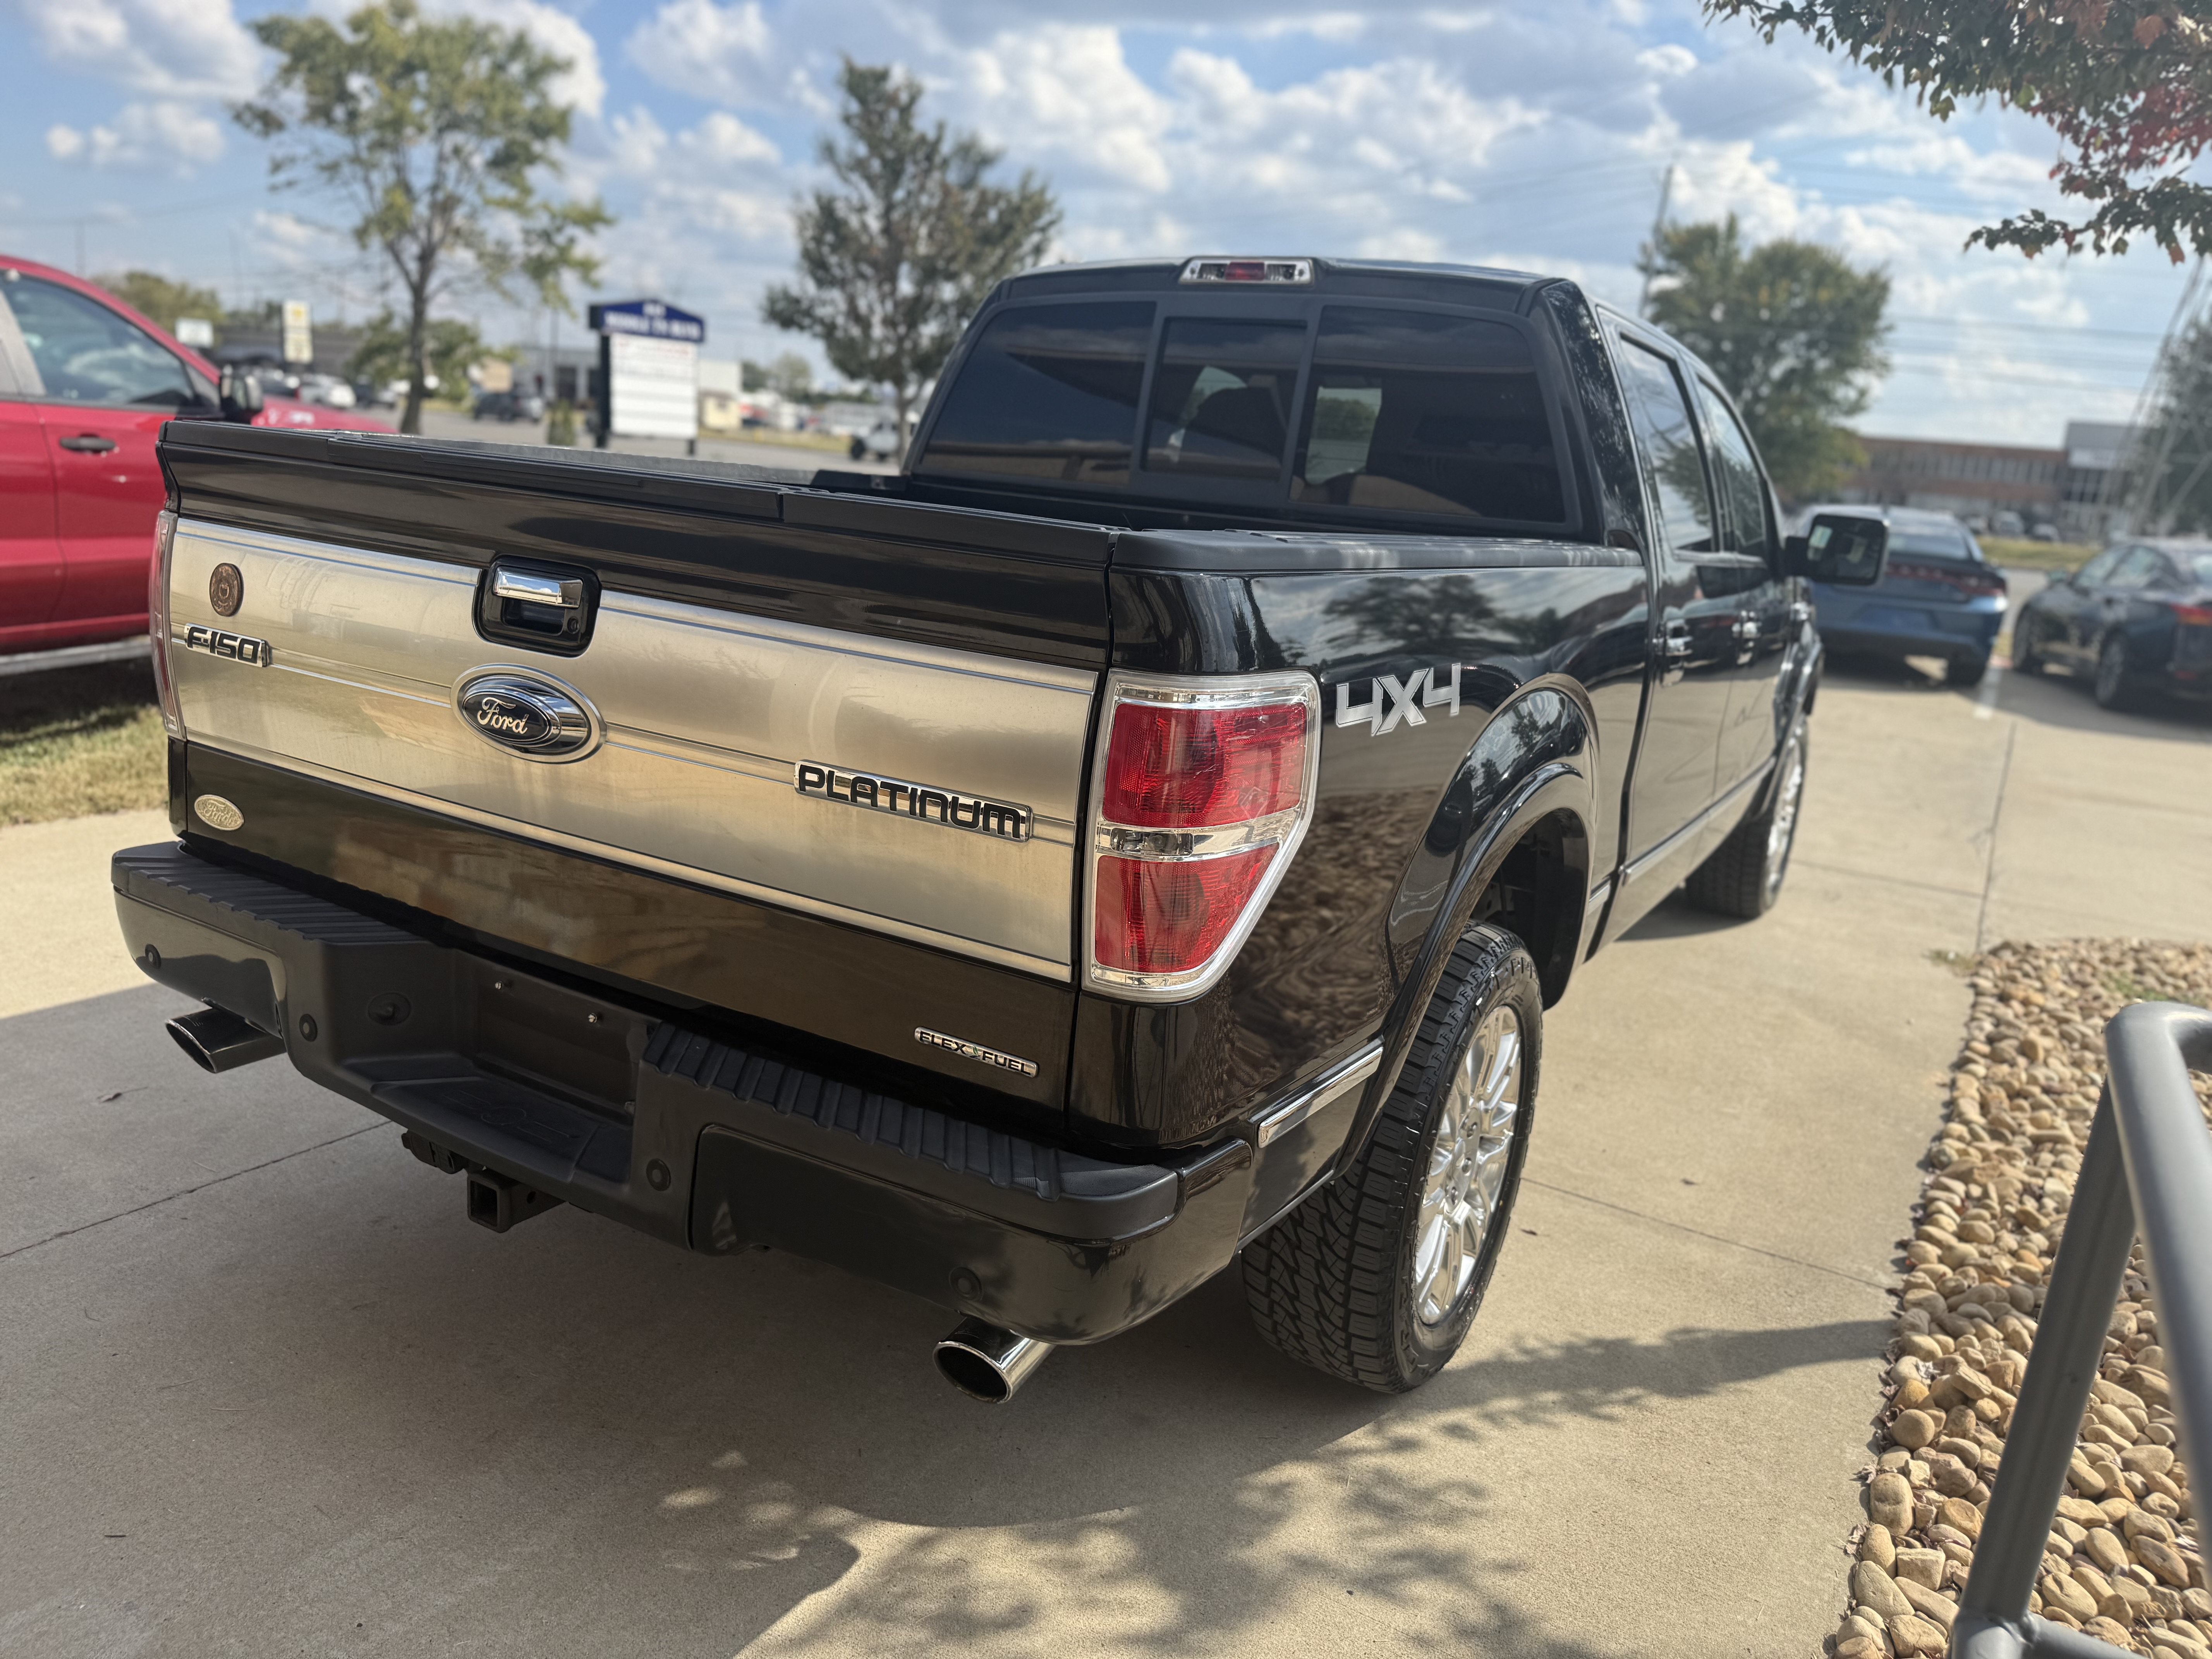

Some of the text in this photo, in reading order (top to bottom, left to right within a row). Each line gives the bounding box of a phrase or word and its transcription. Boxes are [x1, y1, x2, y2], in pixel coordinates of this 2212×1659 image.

[477, 697, 529, 735] Ford
[799, 764, 1022, 839] PLATINUM
[919, 1030, 1031, 1075] FLEX FUEL
